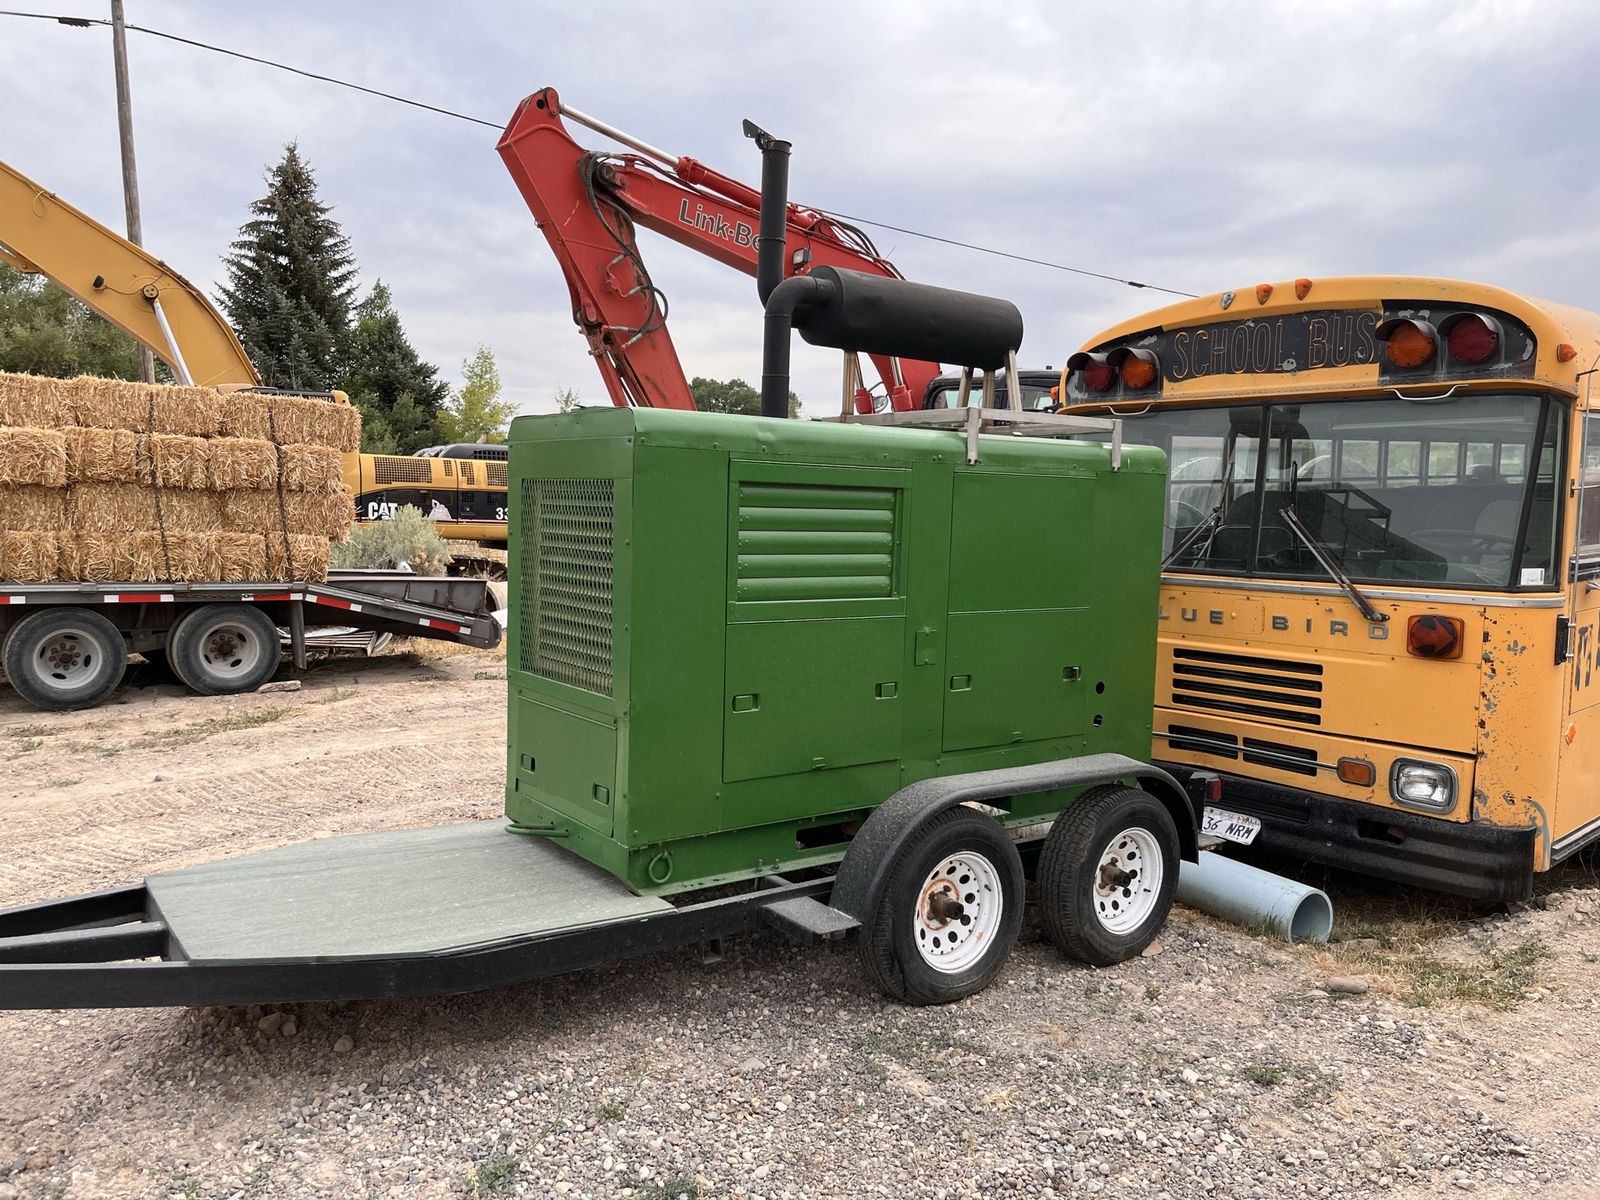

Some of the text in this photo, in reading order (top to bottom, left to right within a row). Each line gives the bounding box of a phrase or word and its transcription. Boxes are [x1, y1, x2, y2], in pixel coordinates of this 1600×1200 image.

[1172, 312, 1376, 379] SCHOOL BUS
[368, 501, 399, 520] CAT
[1272, 615, 1389, 640] BIRD
[1225, 822, 1254, 840] NRM
